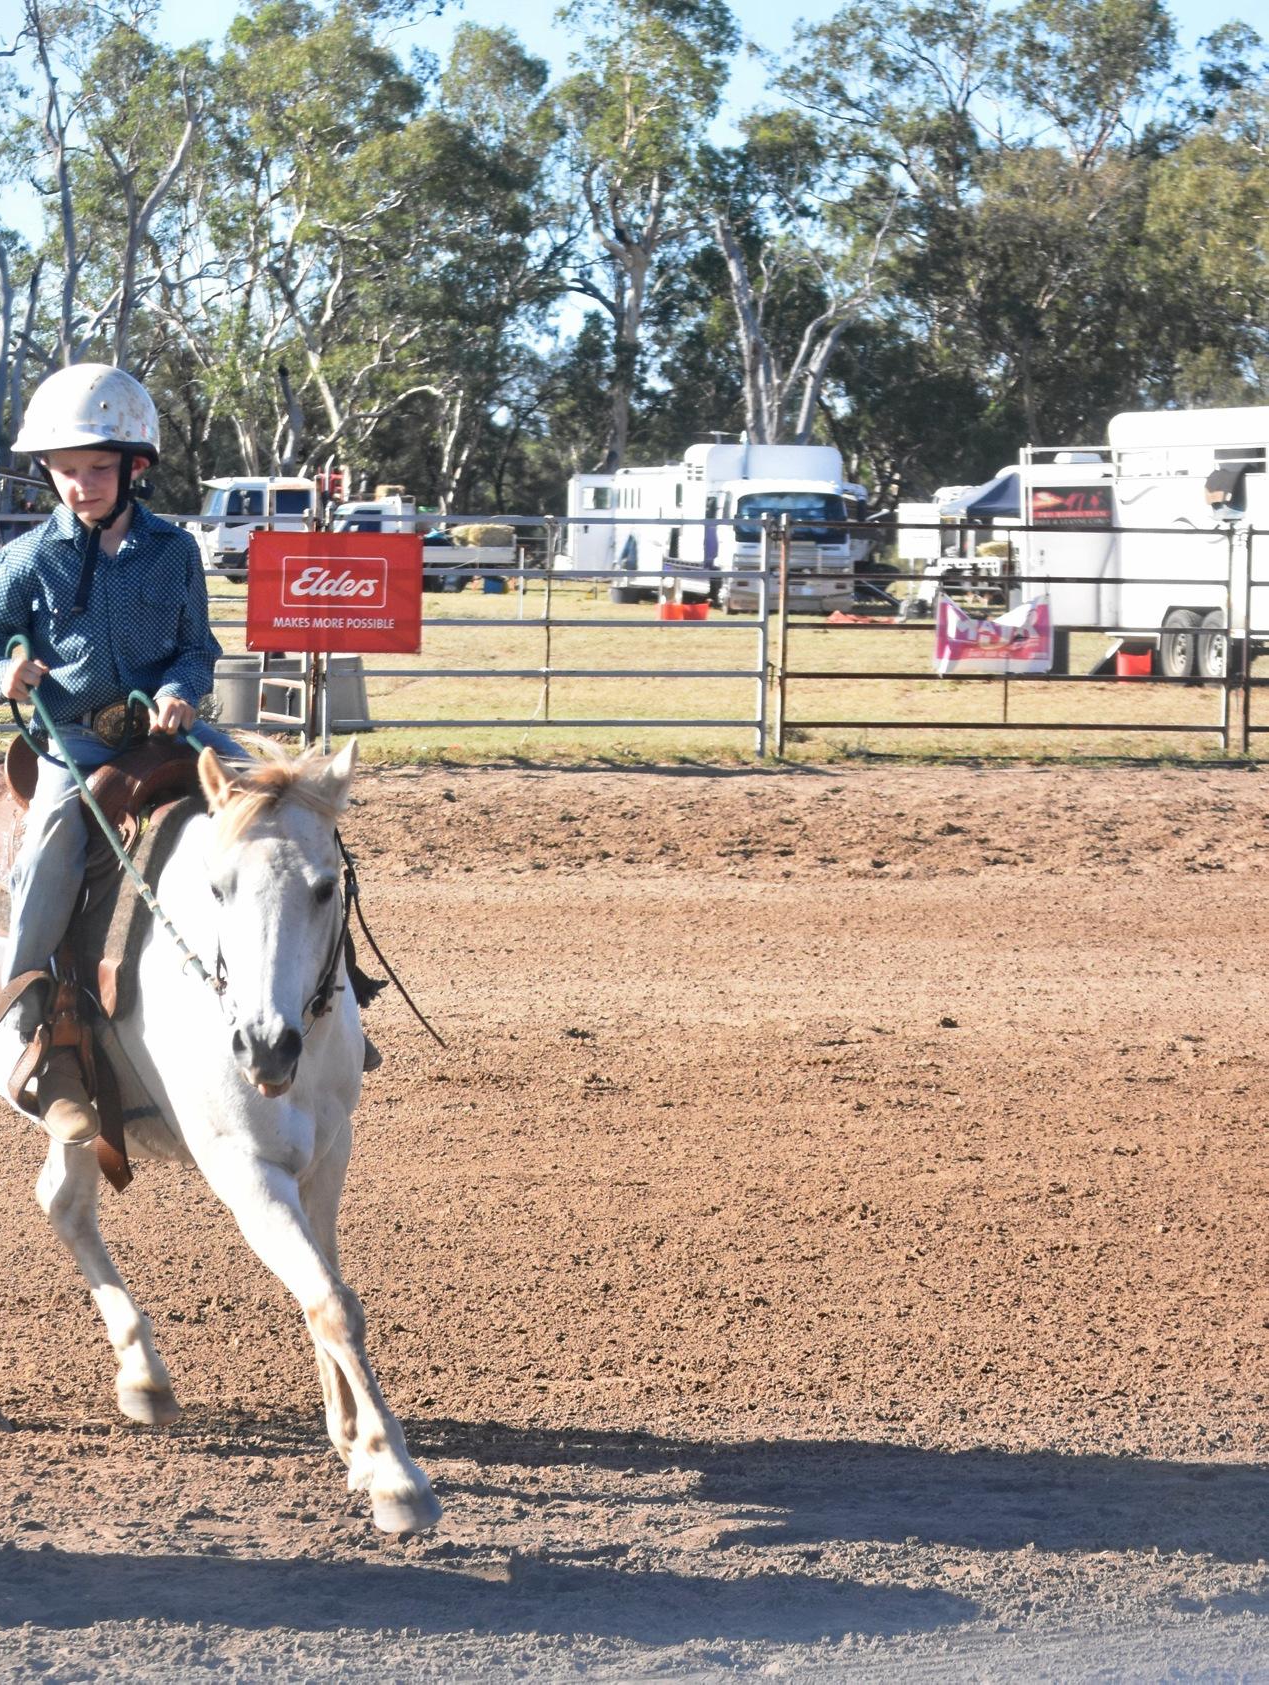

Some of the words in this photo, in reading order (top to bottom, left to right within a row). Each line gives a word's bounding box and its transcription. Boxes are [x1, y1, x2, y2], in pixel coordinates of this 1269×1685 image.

[290, 566, 379, 597] Elders
[273, 617, 311, 628] MAKES
[312, 617, 344, 629] MORE
[346, 617, 395, 629] POSSIBLE
